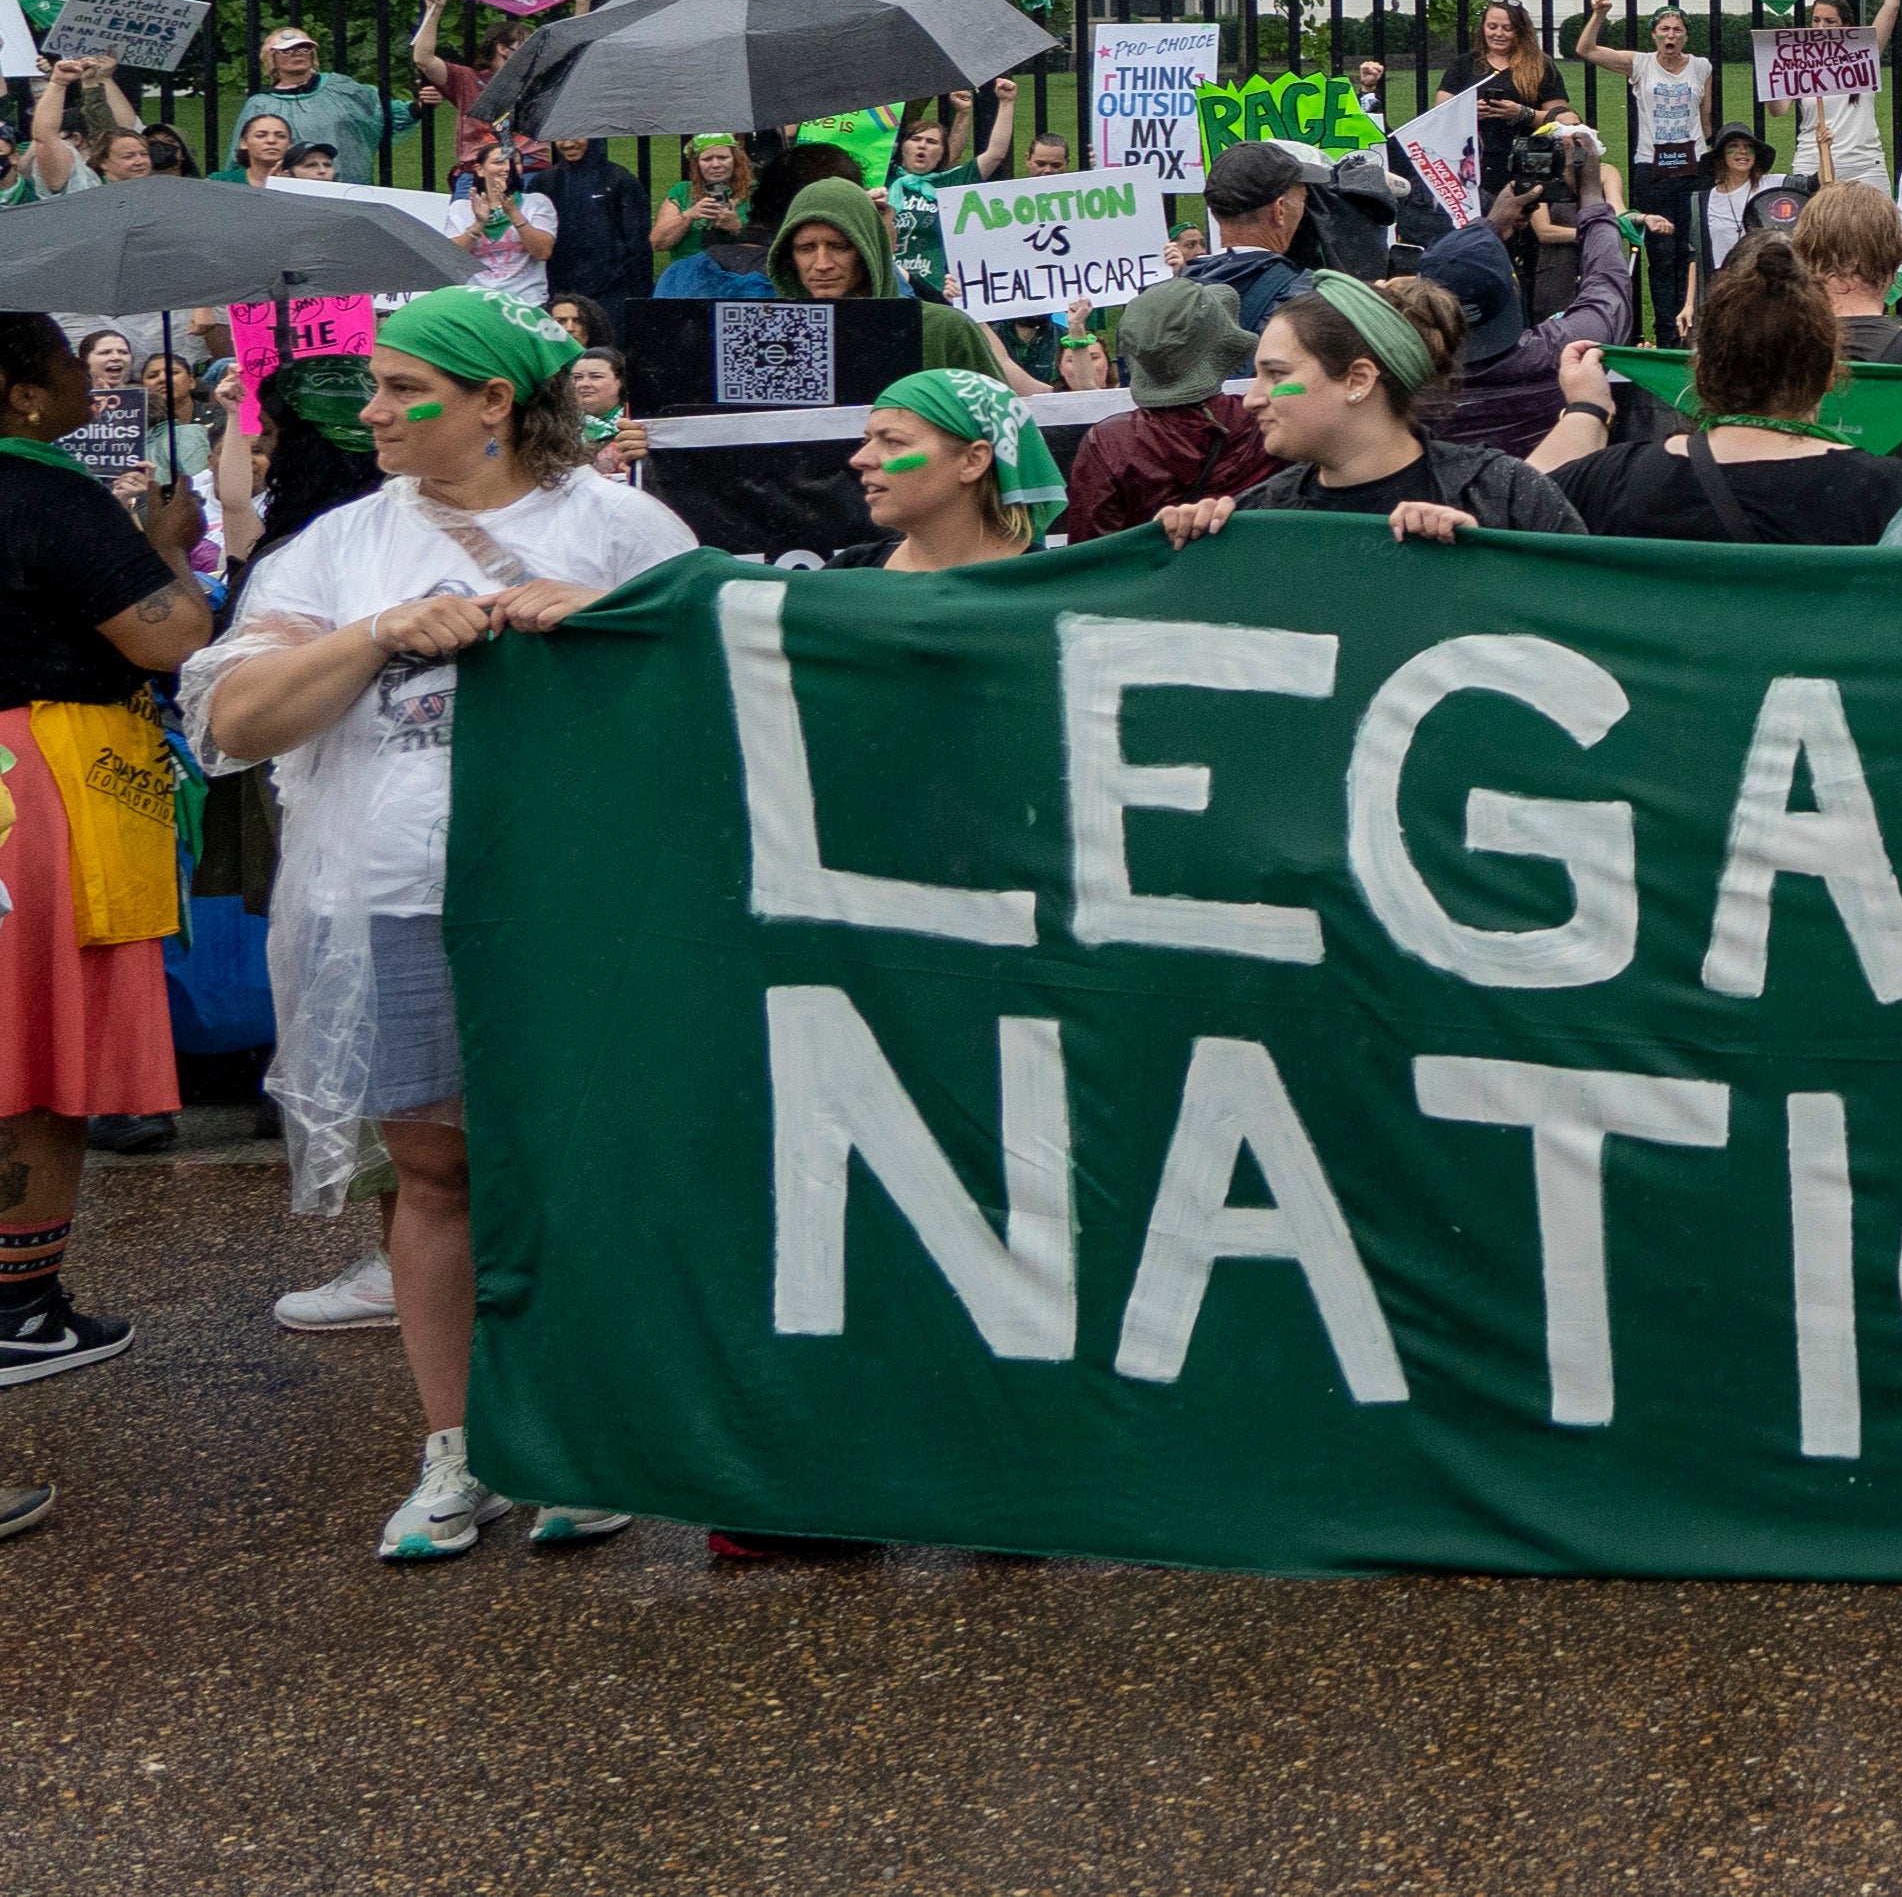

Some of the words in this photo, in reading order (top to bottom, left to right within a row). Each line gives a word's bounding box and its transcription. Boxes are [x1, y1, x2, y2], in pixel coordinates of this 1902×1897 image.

[75, 14, 102, 27] and
[107, 17, 177, 42] ENDS
[94, 6, 193, 30] CONCEPTION
[1113, 31, 1217, 61] PRO-CHOICE
[1775, 27, 1861, 47] PUBLIC
[1773, 48, 1871, 76] ANNOUNCEMENT
[1777, 39, 1849, 63] CERVIX
[1115, 66, 1197, 91] THINK
[1769, 67, 1829, 99] FUCK
[1828, 58, 1879, 92] YOU!
[1097, 91, 1196, 118] OUTSID
[838, 119, 854, 134] is
[1200, 77, 1361, 161] RAGE
[1130, 118, 1179, 149] MY
[953, 182, 1137, 235] ABORTION
[1022, 223, 1071, 256] is
[956, 253, 1160, 310] HEALTHCARE
[105, 407, 141, 430] your
[63, 440, 87, 455] out
[89, 439, 109, 455] of
[111, 440, 137, 460] my
[74, 450, 141, 468] terus
